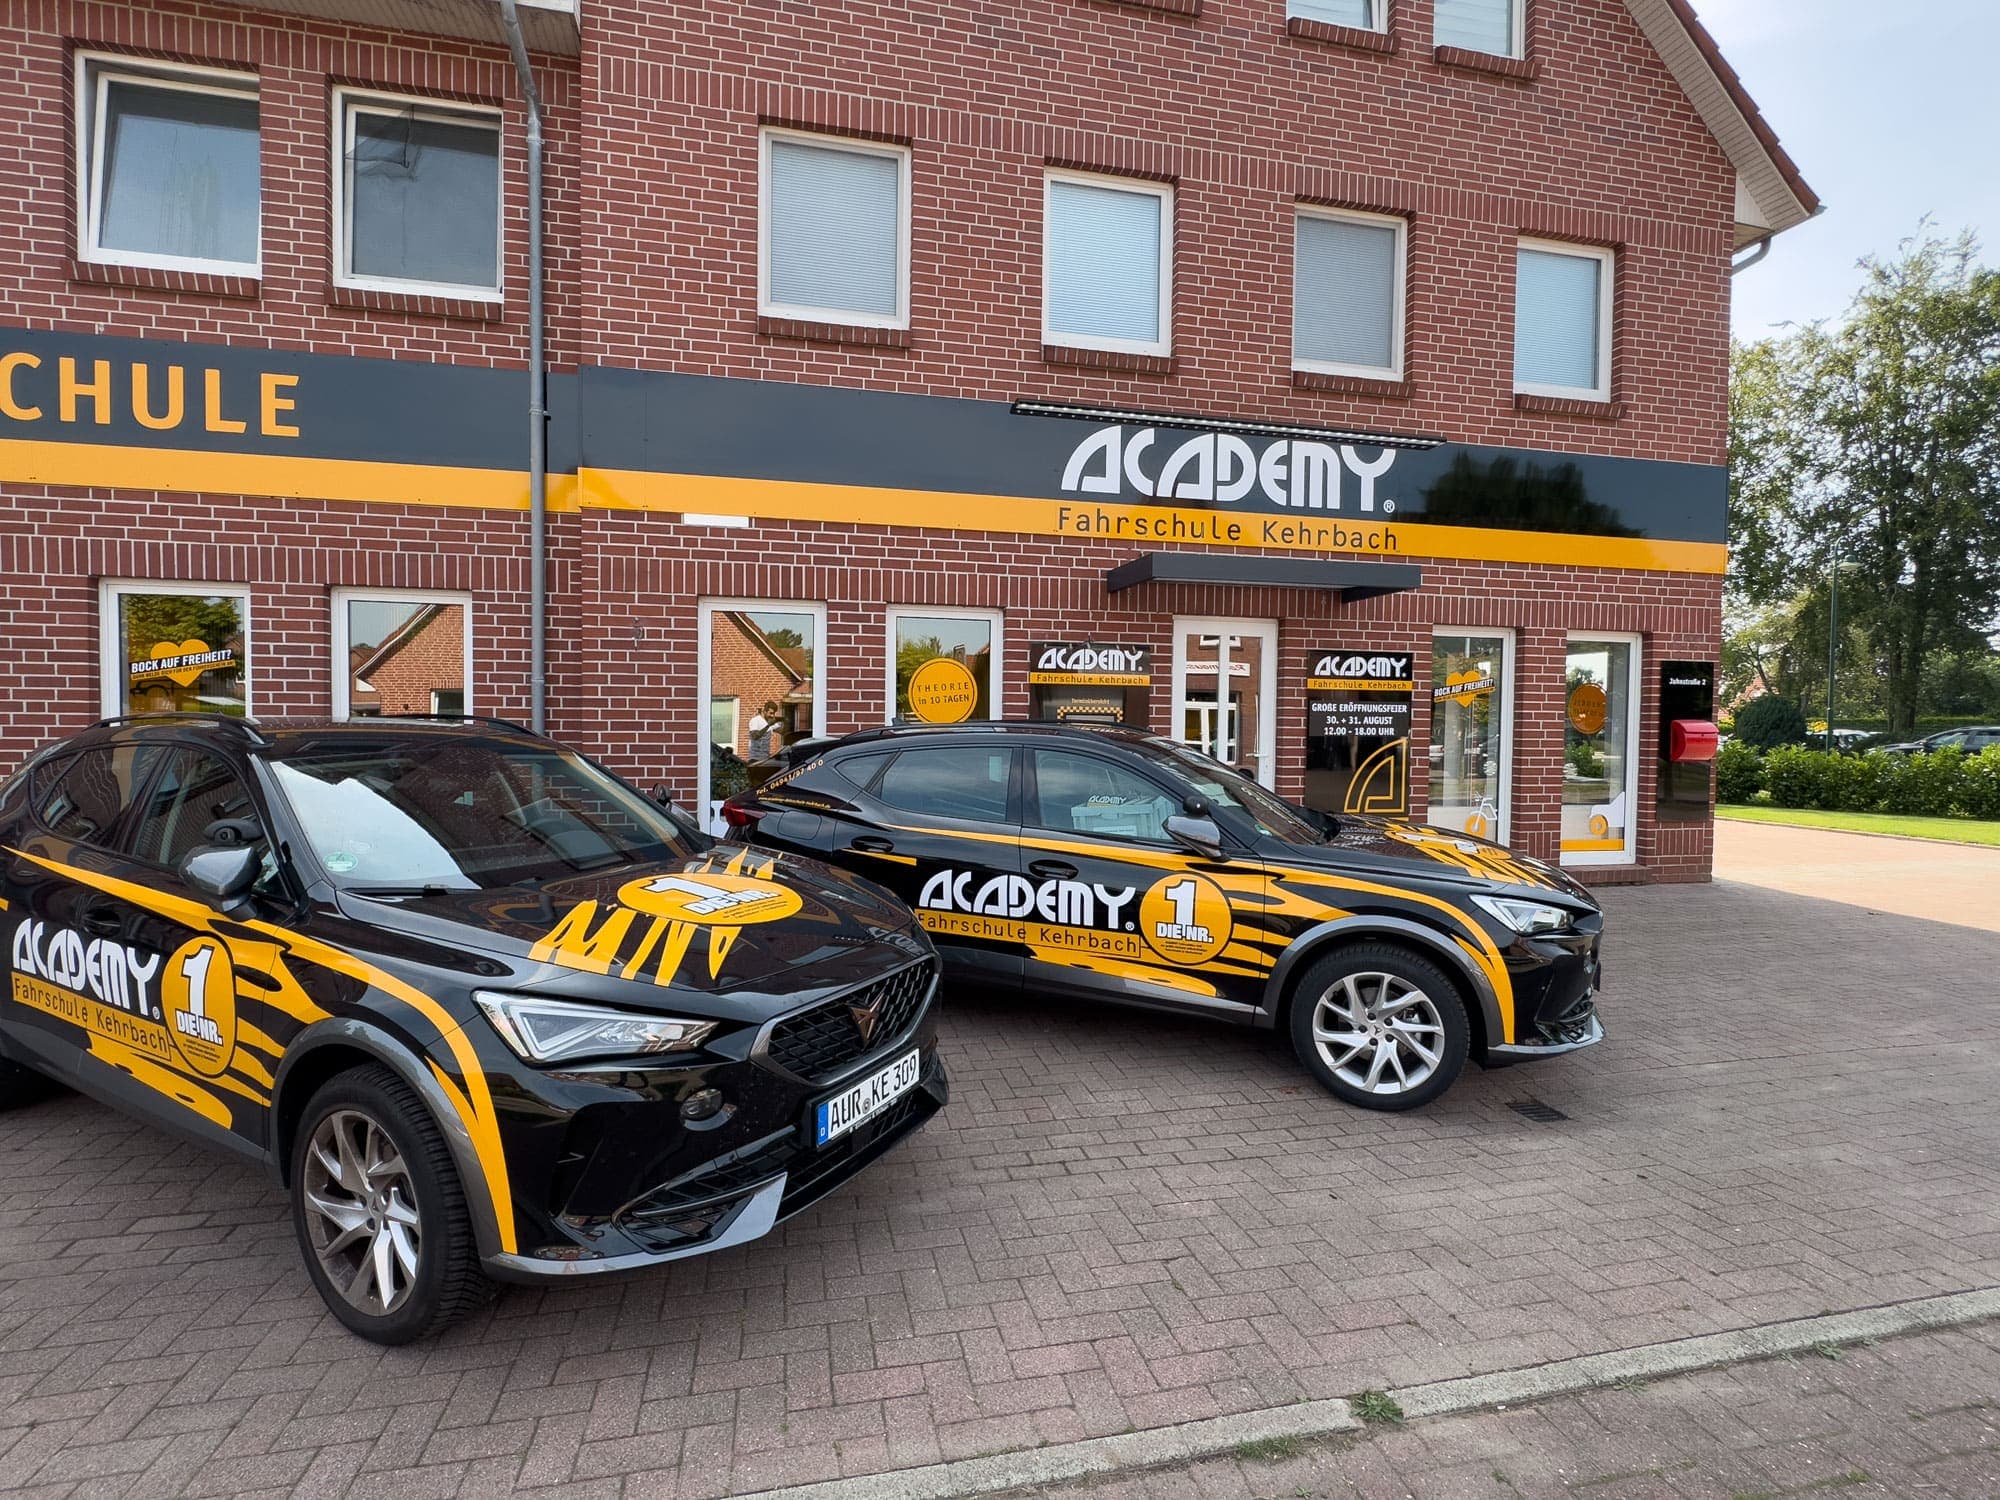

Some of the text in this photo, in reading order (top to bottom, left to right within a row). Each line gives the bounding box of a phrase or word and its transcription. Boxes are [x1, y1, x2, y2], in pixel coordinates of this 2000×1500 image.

[0, 352, 300, 437] CHULE
[1058, 507, 1398, 551] Fahrschule Kehrbach
[131, 650, 232, 673] BOCK AUF FREIHEIT?
[917, 682, 969, 692] THEORIE
[1036, 674, 1144, 684] Fahrschule Kehrbach
[1313, 680, 1407, 690] Fahrschule Kehrbach
[930, 696, 940, 704] 10
[943, 694, 969, 704] TAGEN
[1339, 702, 1408, 713] ERÖFFNUNGSFEIER
[1324, 726, 1346, 736] 12.00
[1354, 727, 1376, 736] 18.00
[1378, 727, 1394, 736] UHR
[1326, 716, 1339, 724] 30.
[1348, 716, 1361, 724] 31.
[1363, 716, 1394, 725] AUGUST
[756, 786, 769, 796] Tel.
[640, 876, 734, 900] 1
[1166, 880, 1196, 925] 1
[918, 913, 1026, 940] Fahrschule
[1040, 928, 1137, 954] Kehrbach
[1156, 922, 1214, 943] DIE NR.
[182, 946, 214, 1017] 1
[14, 978, 88, 1023] Fahrschule
[96, 1008, 168, 1054] Kehrbach
[176, 1009, 224, 1046] DIE NR.
[831, 1088, 860, 1132] AUR
[872, 1071, 890, 1106] KE
[893, 1054, 916, 1091] 309
